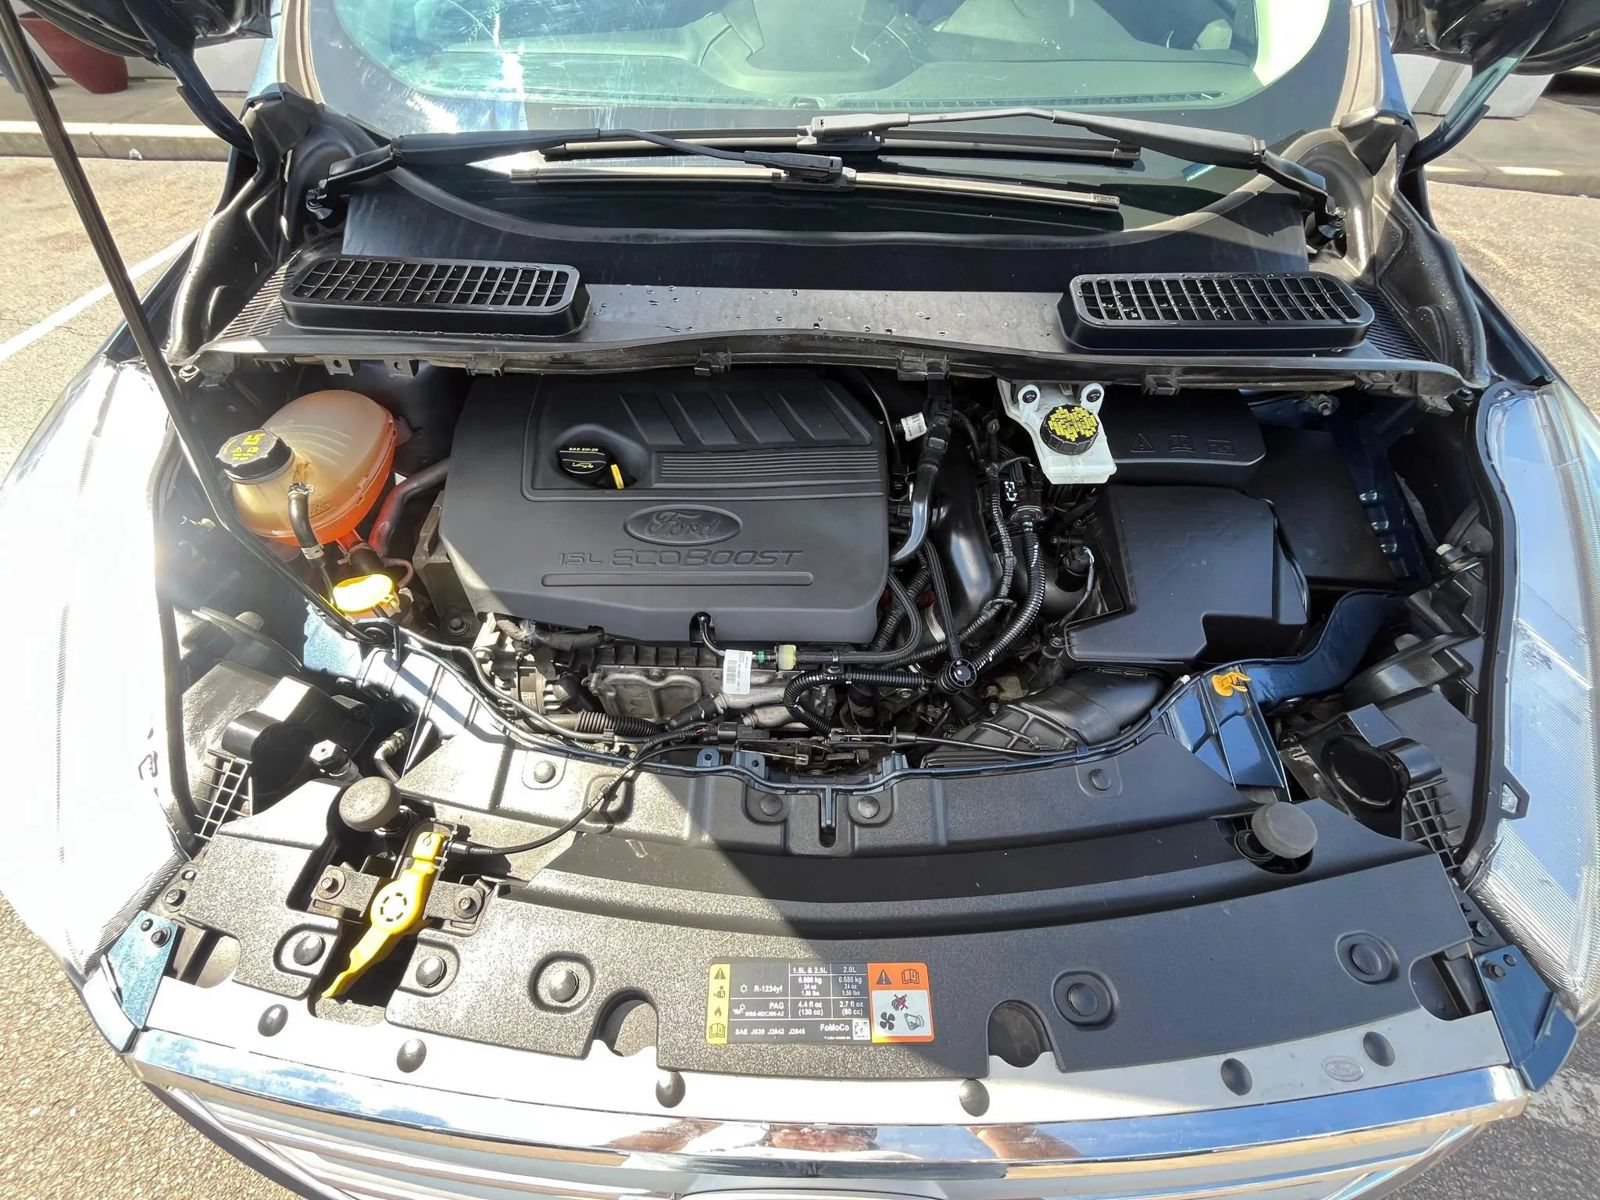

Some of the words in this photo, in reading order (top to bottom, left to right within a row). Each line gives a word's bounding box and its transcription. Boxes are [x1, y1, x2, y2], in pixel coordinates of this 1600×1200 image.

[645, 509, 723, 538] Ford
[843, 966, 857, 974] 2.0L
[814, 976, 823, 985] kg
[854, 976, 863, 985] kg
[754, 984, 783, 995] R-1234yf
[769, 1002, 784, 1010] PAG
[798, 1001, 808, 1009] 4.4
[808, 1001, 814, 1009] fl
[798, 1008, 813, 1017] (130
[813, 1009, 824, 1017] cc)
[853, 1008, 863, 1016] cc)
[820, 1023, 850, 1031] FoMoCo
